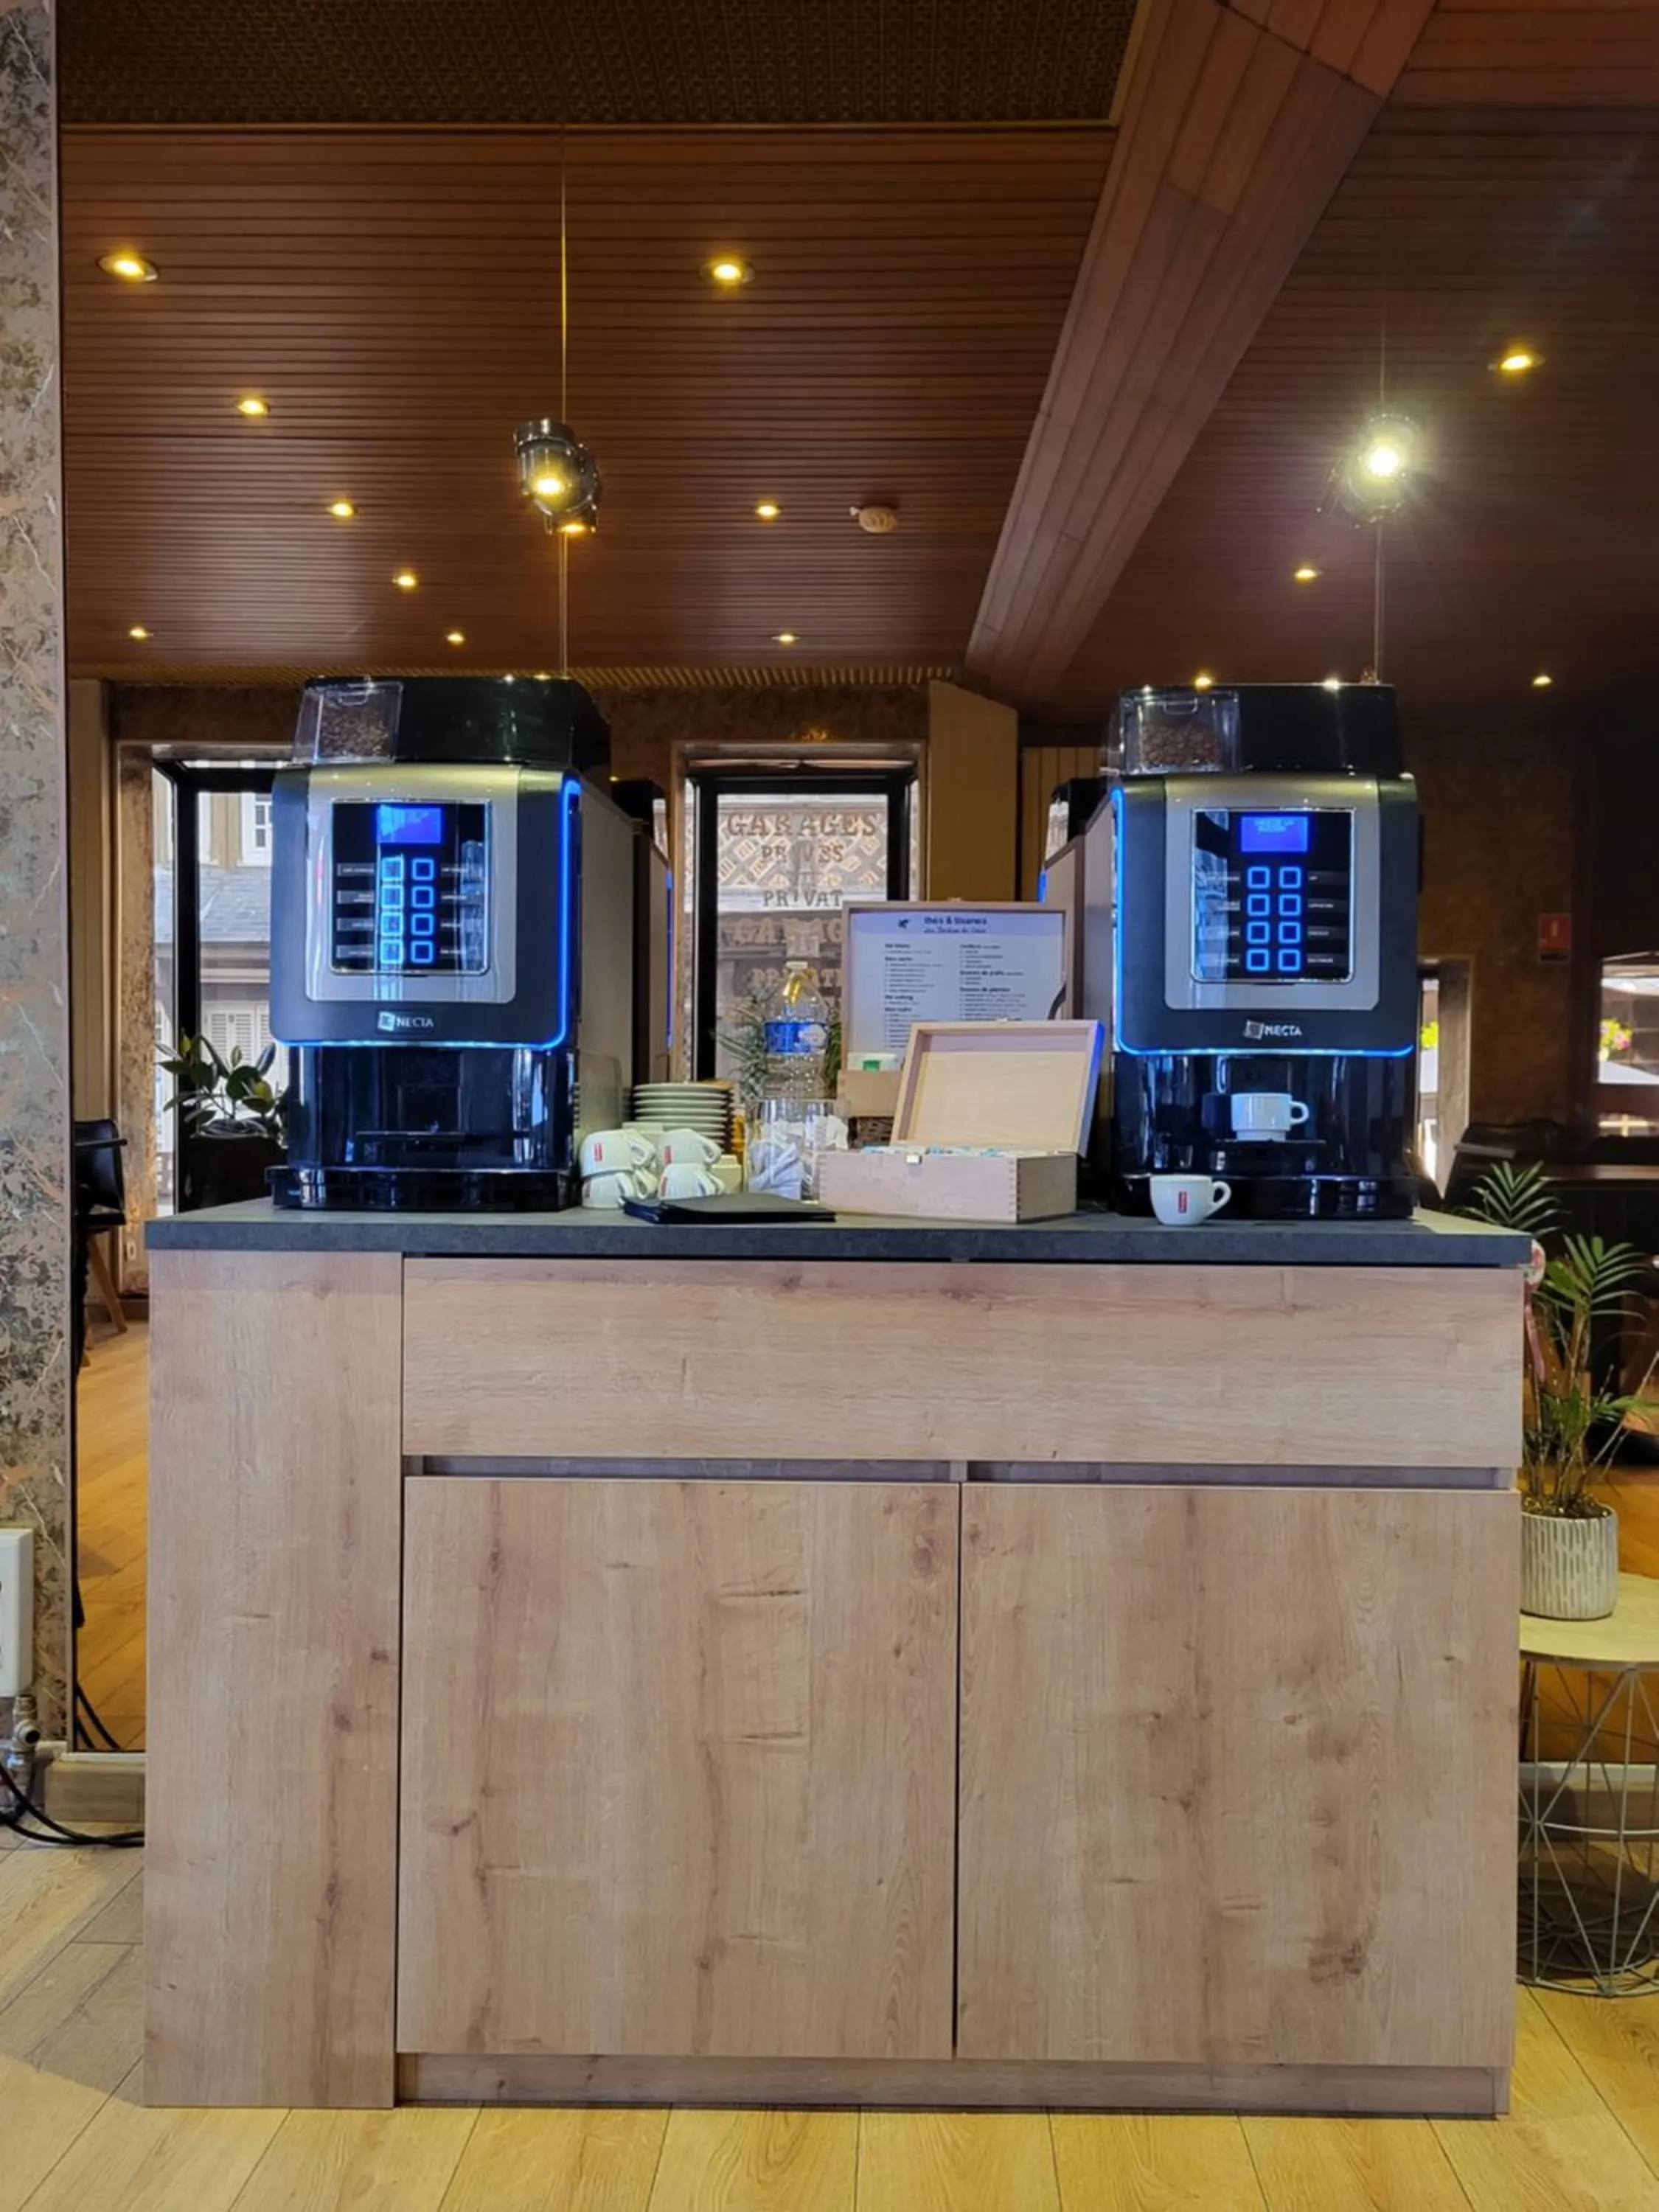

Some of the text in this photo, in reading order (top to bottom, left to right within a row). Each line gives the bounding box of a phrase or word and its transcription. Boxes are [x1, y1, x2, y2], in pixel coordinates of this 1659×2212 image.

[727, 812, 877, 836] GARAGES
[396, 1018, 434, 1027] NECTA
[1264, 1025, 1302, 1036] NECTA
